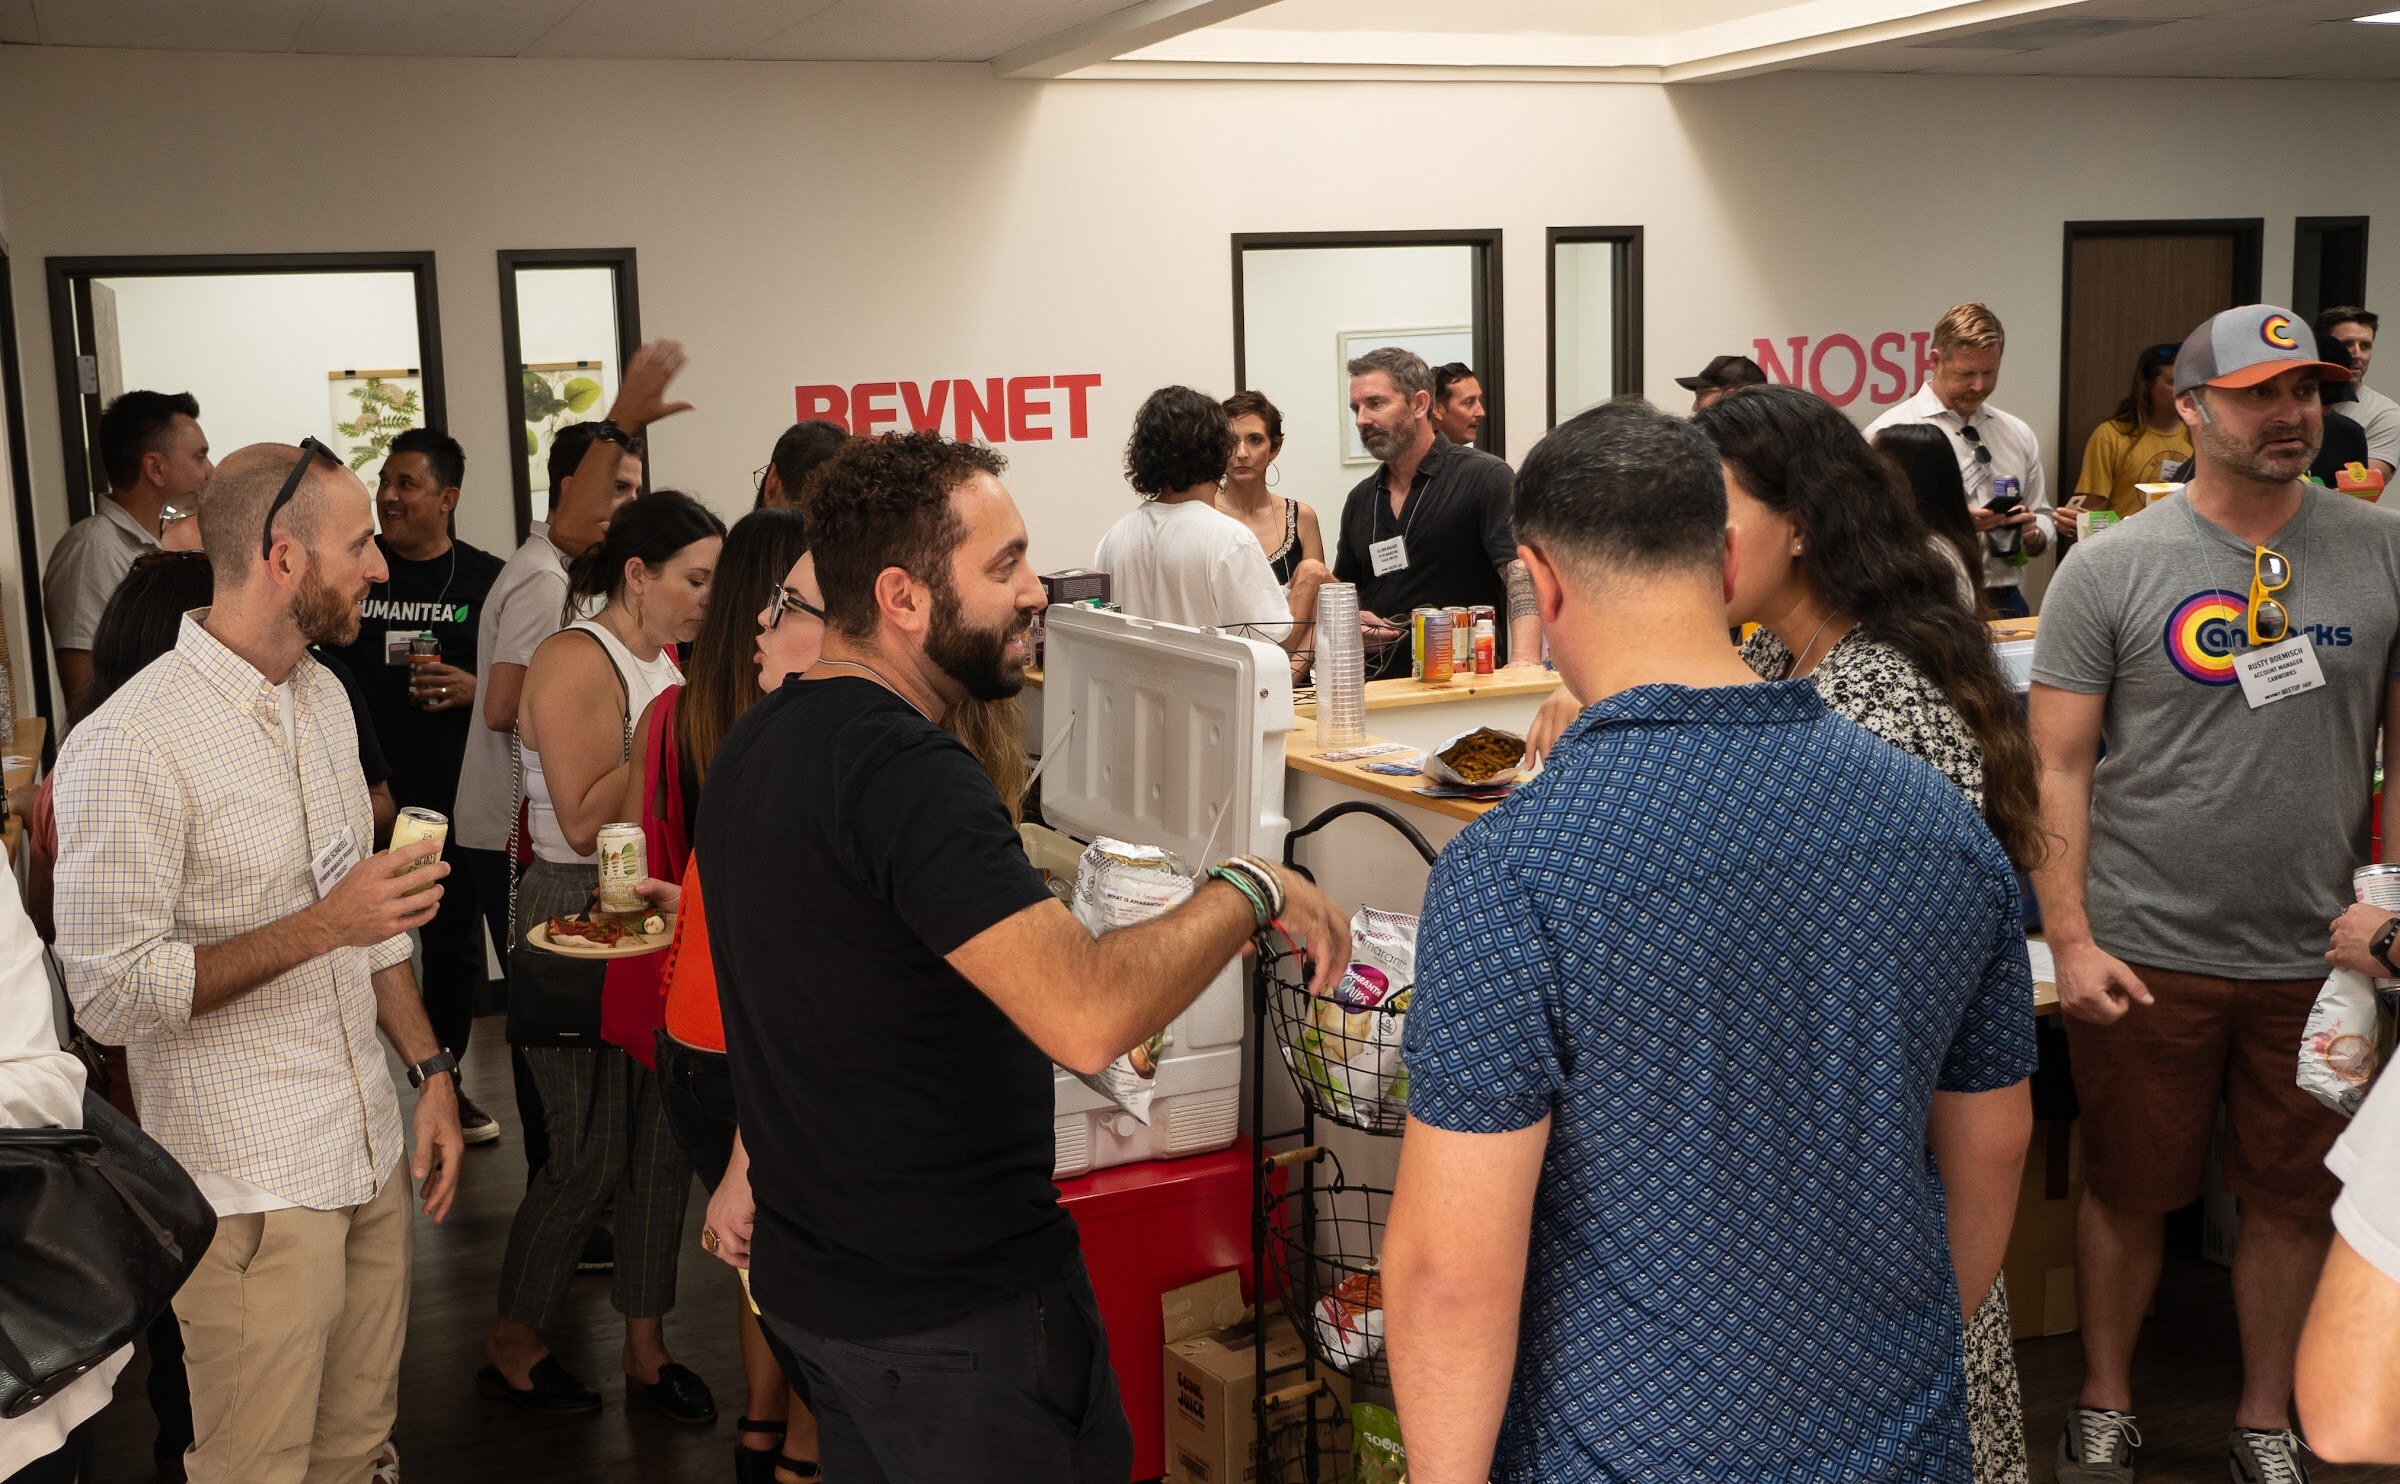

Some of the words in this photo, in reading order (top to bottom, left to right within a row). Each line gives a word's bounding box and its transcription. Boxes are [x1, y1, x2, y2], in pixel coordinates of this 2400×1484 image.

[795, 373, 1102, 443] BEVNET
[359, 600, 454, 622] UMANITEA
[2247, 658, 2268, 671] RUSTY
[2269, 647, 2303, 664] ROEMISCH
[2253, 667, 2277, 679] ACCOUNT
[2278, 658, 2304, 670] MANAGER
[2267, 669, 2297, 683] CANWORKS
[2281, 684, 2301, 695] MEETUP
[1107, 893, 1122, 902] WHAT
[1130, 899, 1165, 908] AMARANTH?
[1358, 932, 1408, 972] maranth
[1340, 976, 1370, 1005] Chips
